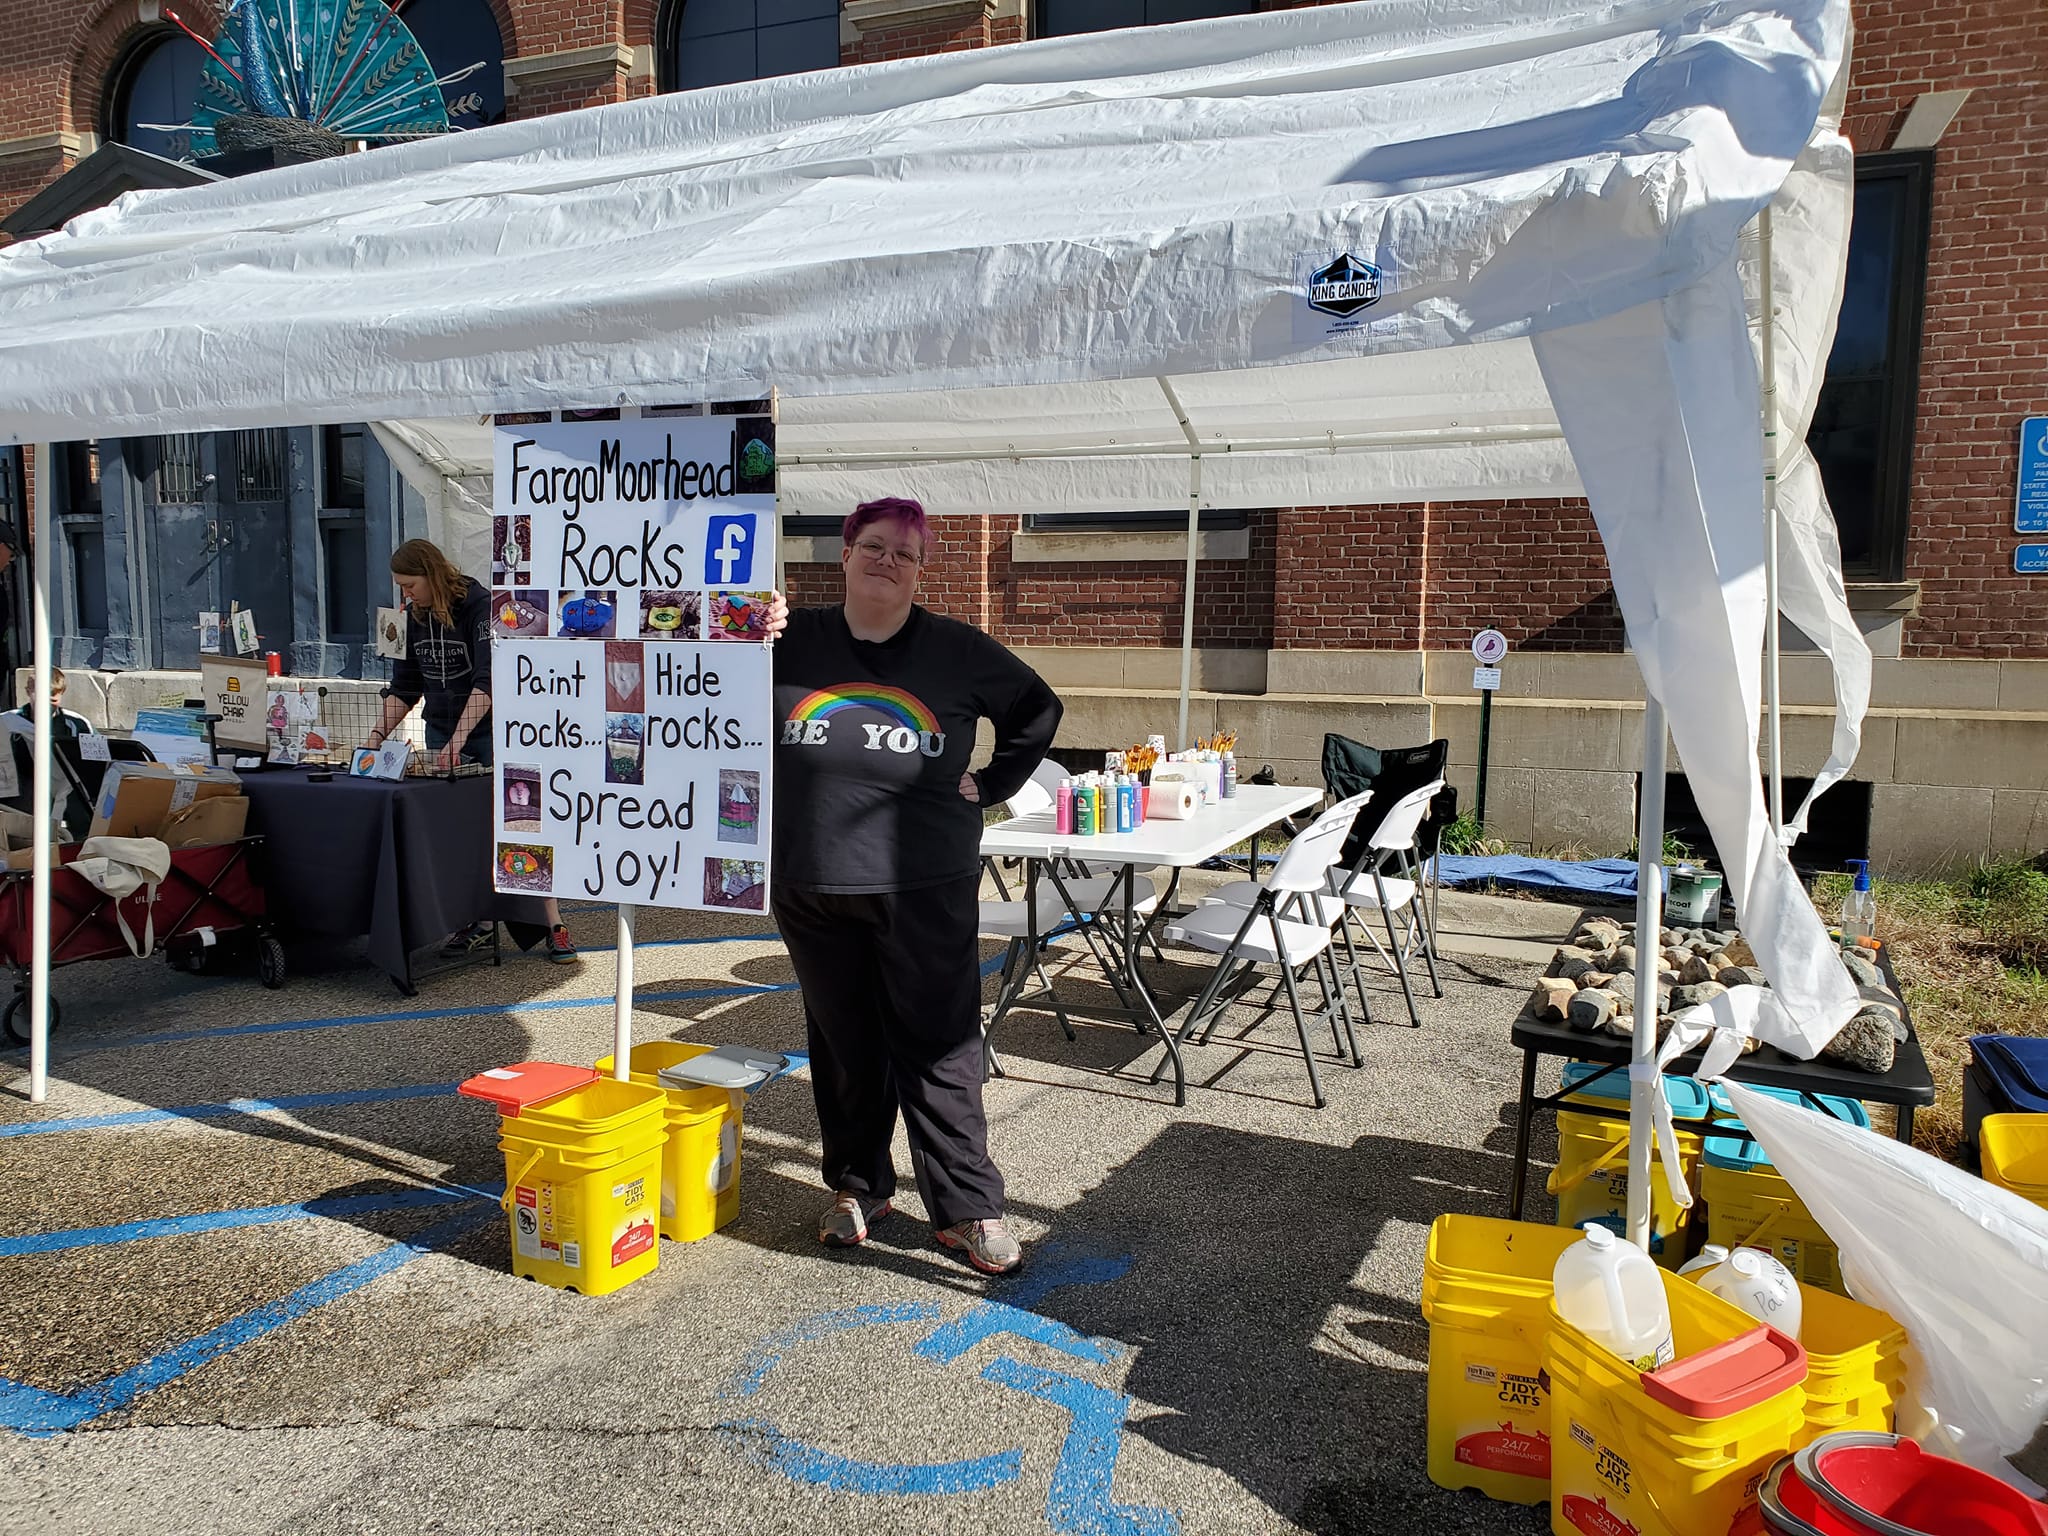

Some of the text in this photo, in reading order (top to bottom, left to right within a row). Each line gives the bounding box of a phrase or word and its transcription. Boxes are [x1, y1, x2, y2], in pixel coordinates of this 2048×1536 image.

[1311, 281, 1379, 301] KING CANOPY
[512, 430, 736, 521] FargoMoorhead
[2018, 519, 2030, 527] UP
[2032, 519, 2044, 527] TO
[517, 652, 722, 698] Paint Hide
[217, 693, 250, 707] YELLOW
[222, 706, 245, 718] CHAIR
[505, 707, 763, 750] rocks... rocks...
[780, 719, 947, 758] BE YOU
[549, 769, 695, 846] Spread
[584, 841, 681, 901] joy!
[134, 893, 162, 905] ULE
[624, 1191, 646, 1207] CATS
[625, 1183, 644, 1198] TIDY
[1500, 1380, 1539, 1396] TIDY
[1498, 1391, 1540, 1407] CATS
[1486, 1445, 1545, 1462] PERFORMANCE
[1502, 1438, 1531, 1452] 24/7
[1598, 1451, 1631, 1481] TIDY
[1595, 1462, 1631, 1495] CATS
